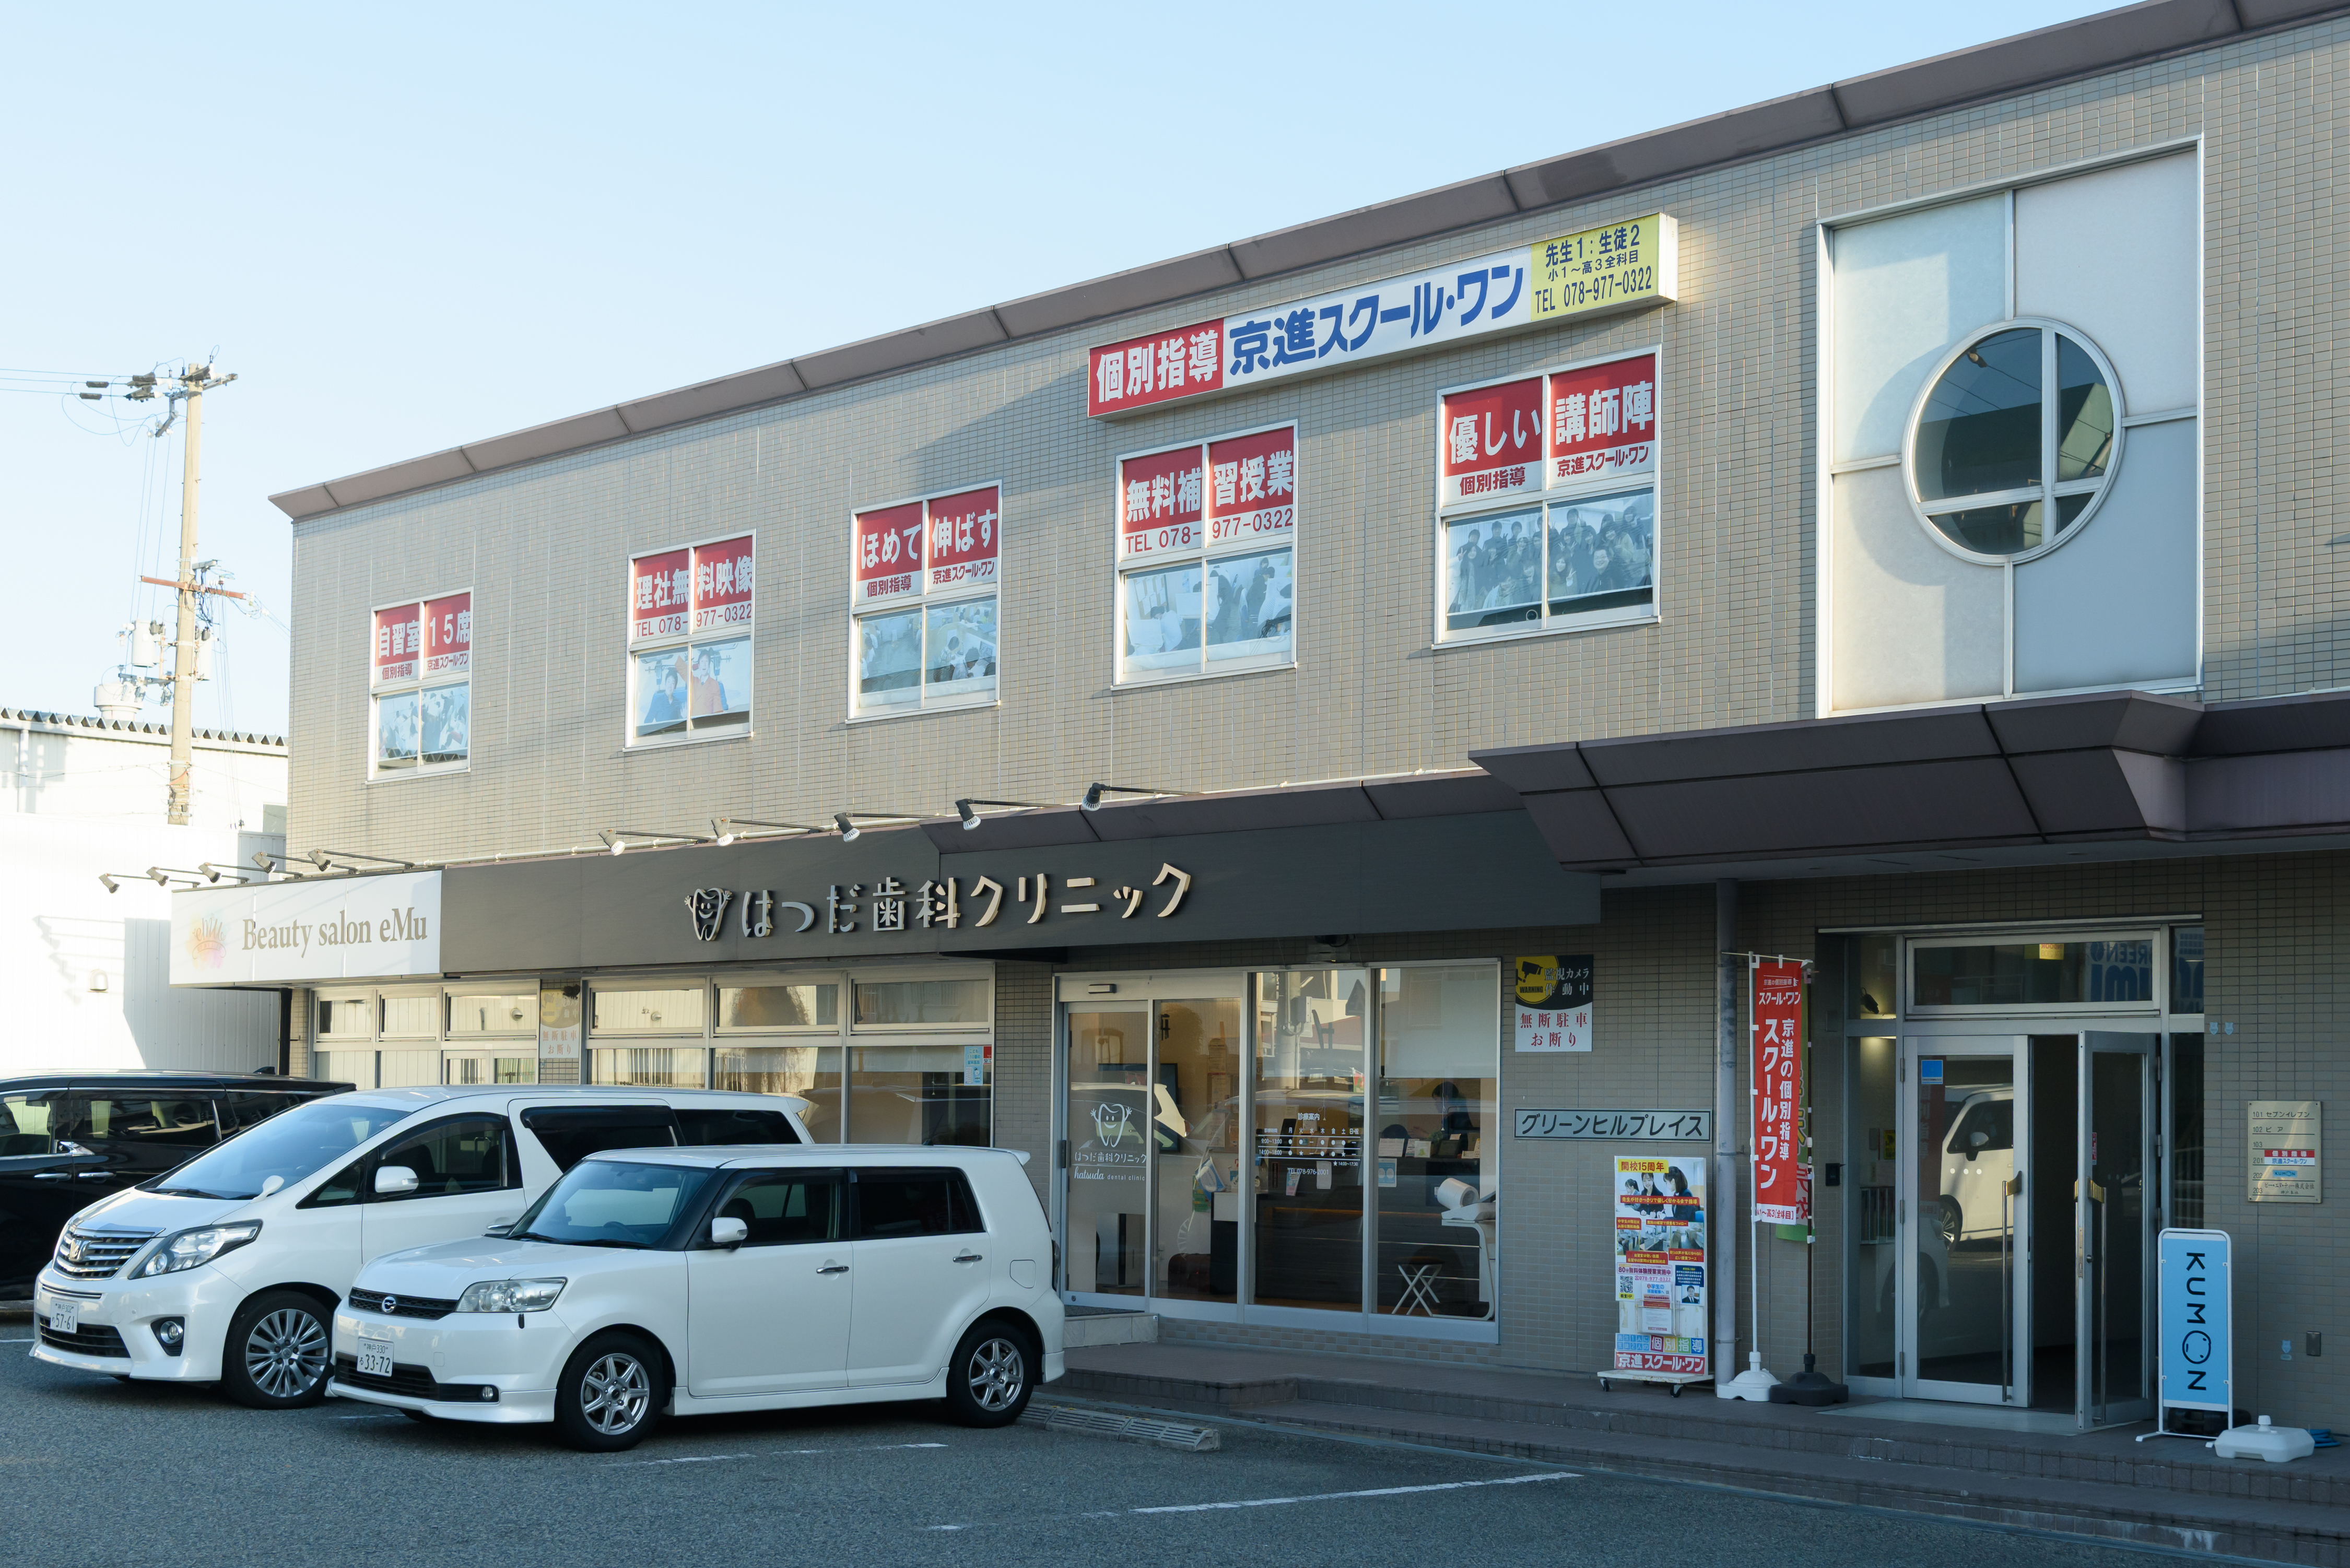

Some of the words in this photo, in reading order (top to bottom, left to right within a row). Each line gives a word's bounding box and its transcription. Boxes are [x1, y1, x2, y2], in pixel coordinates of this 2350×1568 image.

[1535, 288, 1555, 313] TEL
[1564, 265, 1651, 308] 078-977-0322
[1097, 330, 1218, 403] 個別指導
[1229, 264, 1523, 375] 京進スクール・ワン
[1449, 409, 1541, 464] 優しい
[1556, 380, 1654, 445] 講師陣
[1557, 446, 1649, 477] 京進スクール・ワン
[1460, 466, 1525, 496] 個別指導
[862, 523, 922, 570] ほめて
[932, 509, 997, 559] 伸ばす
[1125, 534, 1152, 554] TEL
[1159, 508, 1293, 548] 078-977-0322
[933, 561, 995, 585] 京進スクール・ワン
[867, 574, 912, 598] 個別指導
[635, 621, 654, 638] TEL
[659, 603, 752, 634] 078-977-0322
[379, 620, 420, 658] 自習室
[430, 610, 470, 647] 15席
[382, 663, 413, 680] 個別指導
[427, 653, 468, 671] 京進スクール・ワン
[743, 863, 1191, 937] はつだ歯科クリニック
[242, 918, 313, 959] Beauty
[319, 910, 372, 947] salon
[380, 906, 428, 943] eMu
[1544, 968, 1590, 981] 監視カメラ
[1544, 983, 1589, 996] 作動中
[1759, 992, 1801, 1005] スクール・ワン
[1520, 1012, 1588, 1029] 無断駐車
[543, 1030, 577, 1041] 無断駐車
[1531, 1032, 1576, 1047] お断り
[548, 1044, 571, 1055] お断り
[1779, 1018, 1795, 1161] 京進の個別指導
[1760, 1019, 1779, 1189] スクール・ワン
[1297, 1113, 1320, 1121] 診療案内
[1522, 1113, 1702, 1137] グリーンヒルプレイス
[1075, 1151, 1147, 1164] はつだ歯科クリニック
[1621, 1161, 1665, 1172] 開校15周年
[1074, 1166, 1105, 1181] hatsuda
[56, 1313, 75, 1331] 57-61
[2182, 1252, 2212, 1391] KUMON
[1617, 1334, 1649, 1342] 先生1人に
[1652, 1336, 1703, 1353] 個別指導
[365, 1353, 391, 1374] 33-72
[1618, 1353, 1703, 1372] 京進スクール・ワン
